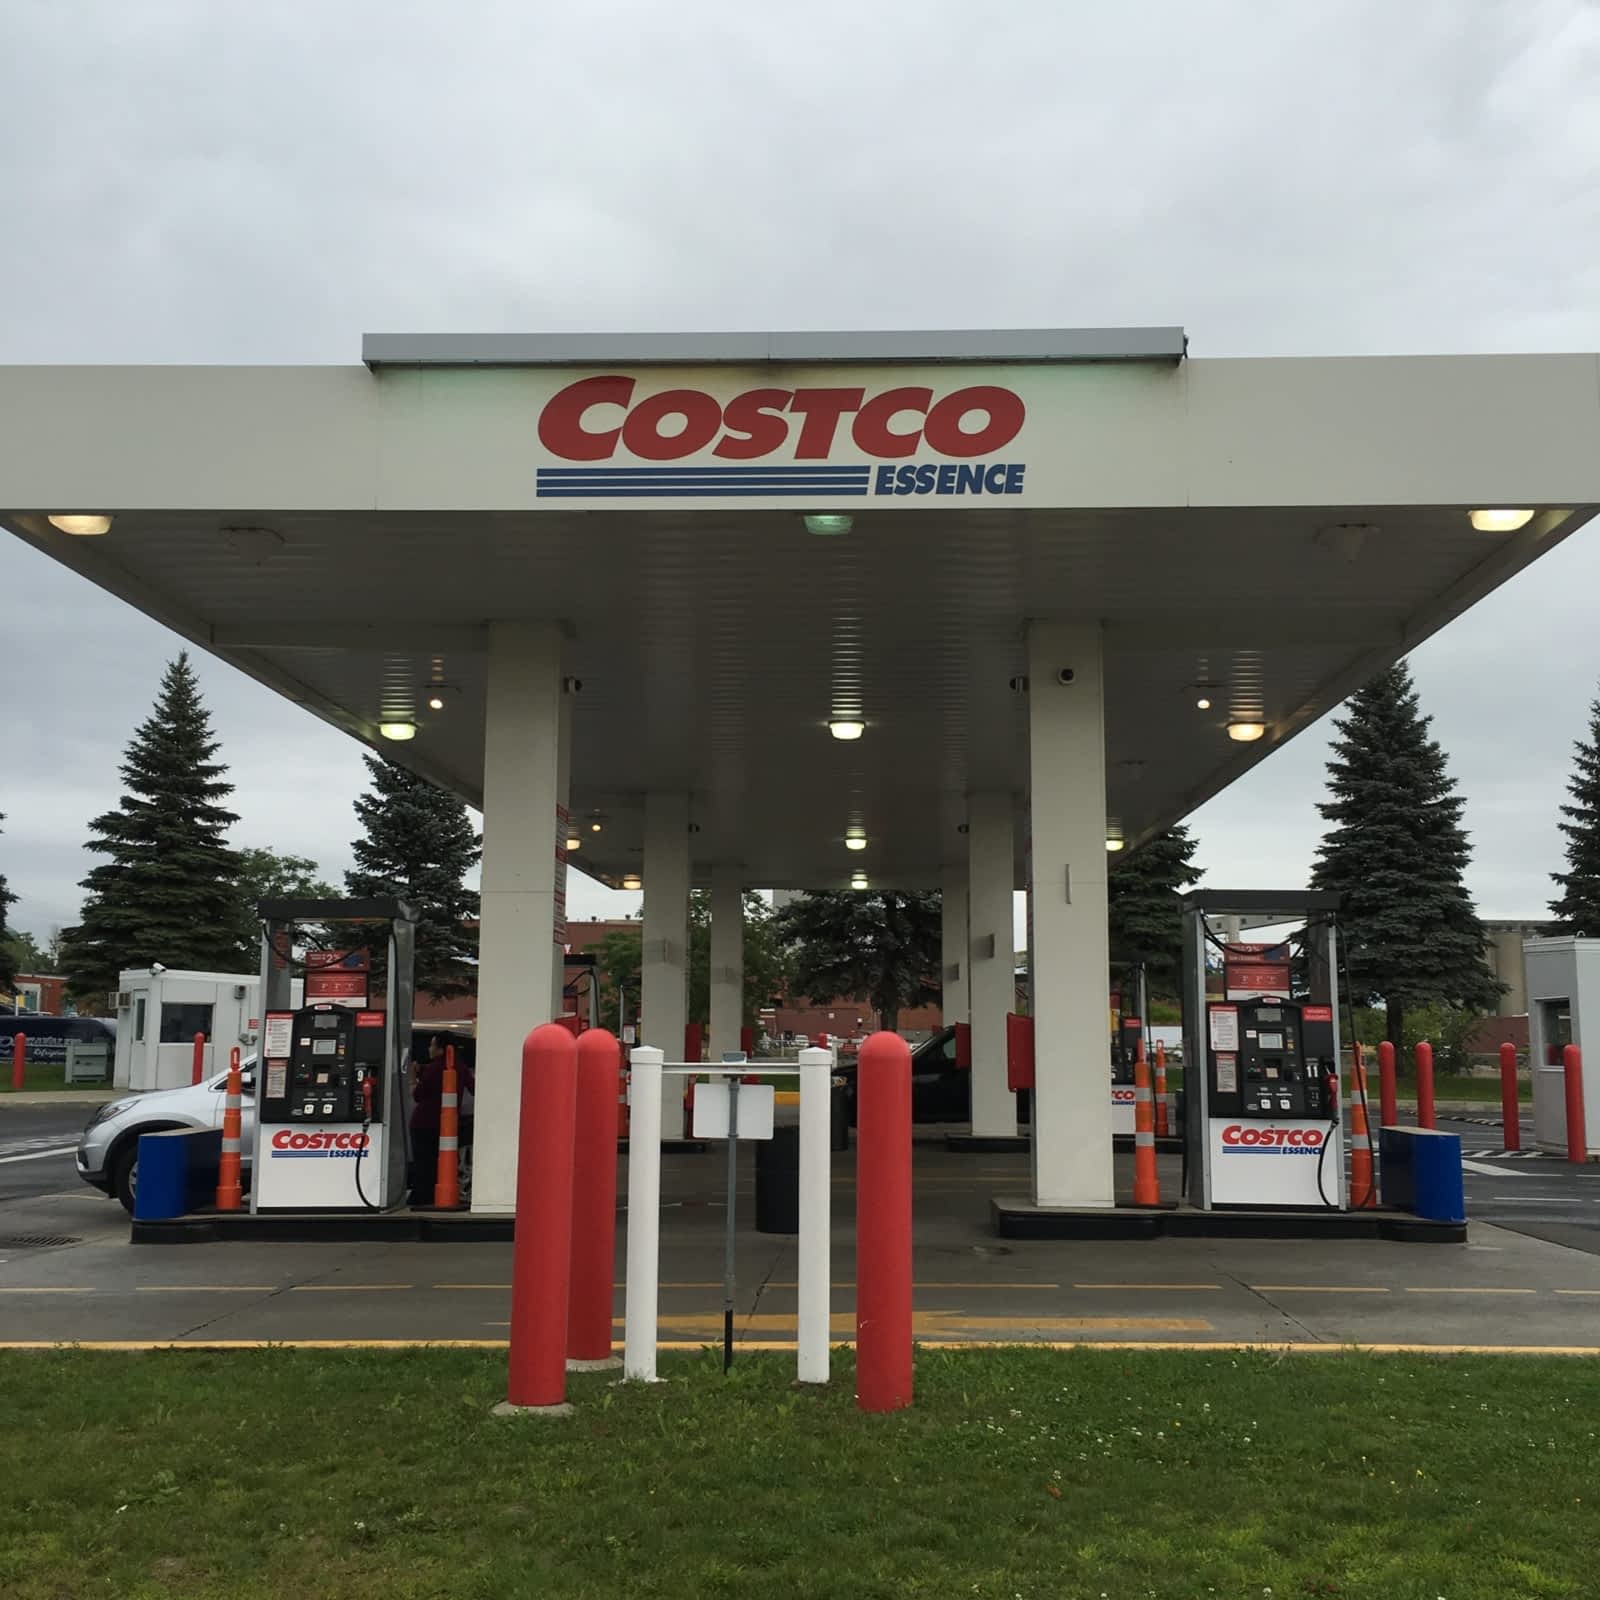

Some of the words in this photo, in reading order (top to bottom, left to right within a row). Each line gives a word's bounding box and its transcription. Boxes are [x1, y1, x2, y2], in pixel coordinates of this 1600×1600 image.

[537, 375, 1026, 461] COSTCO
[874, 464, 1026, 496] ESSENCE
[1307, 1065, 1319, 1078] 11
[272, 1130, 369, 1149] COSTCO
[1222, 1125, 1324, 1146] COSTCO
[1282, 1147, 1322, 1155] ESSENC
